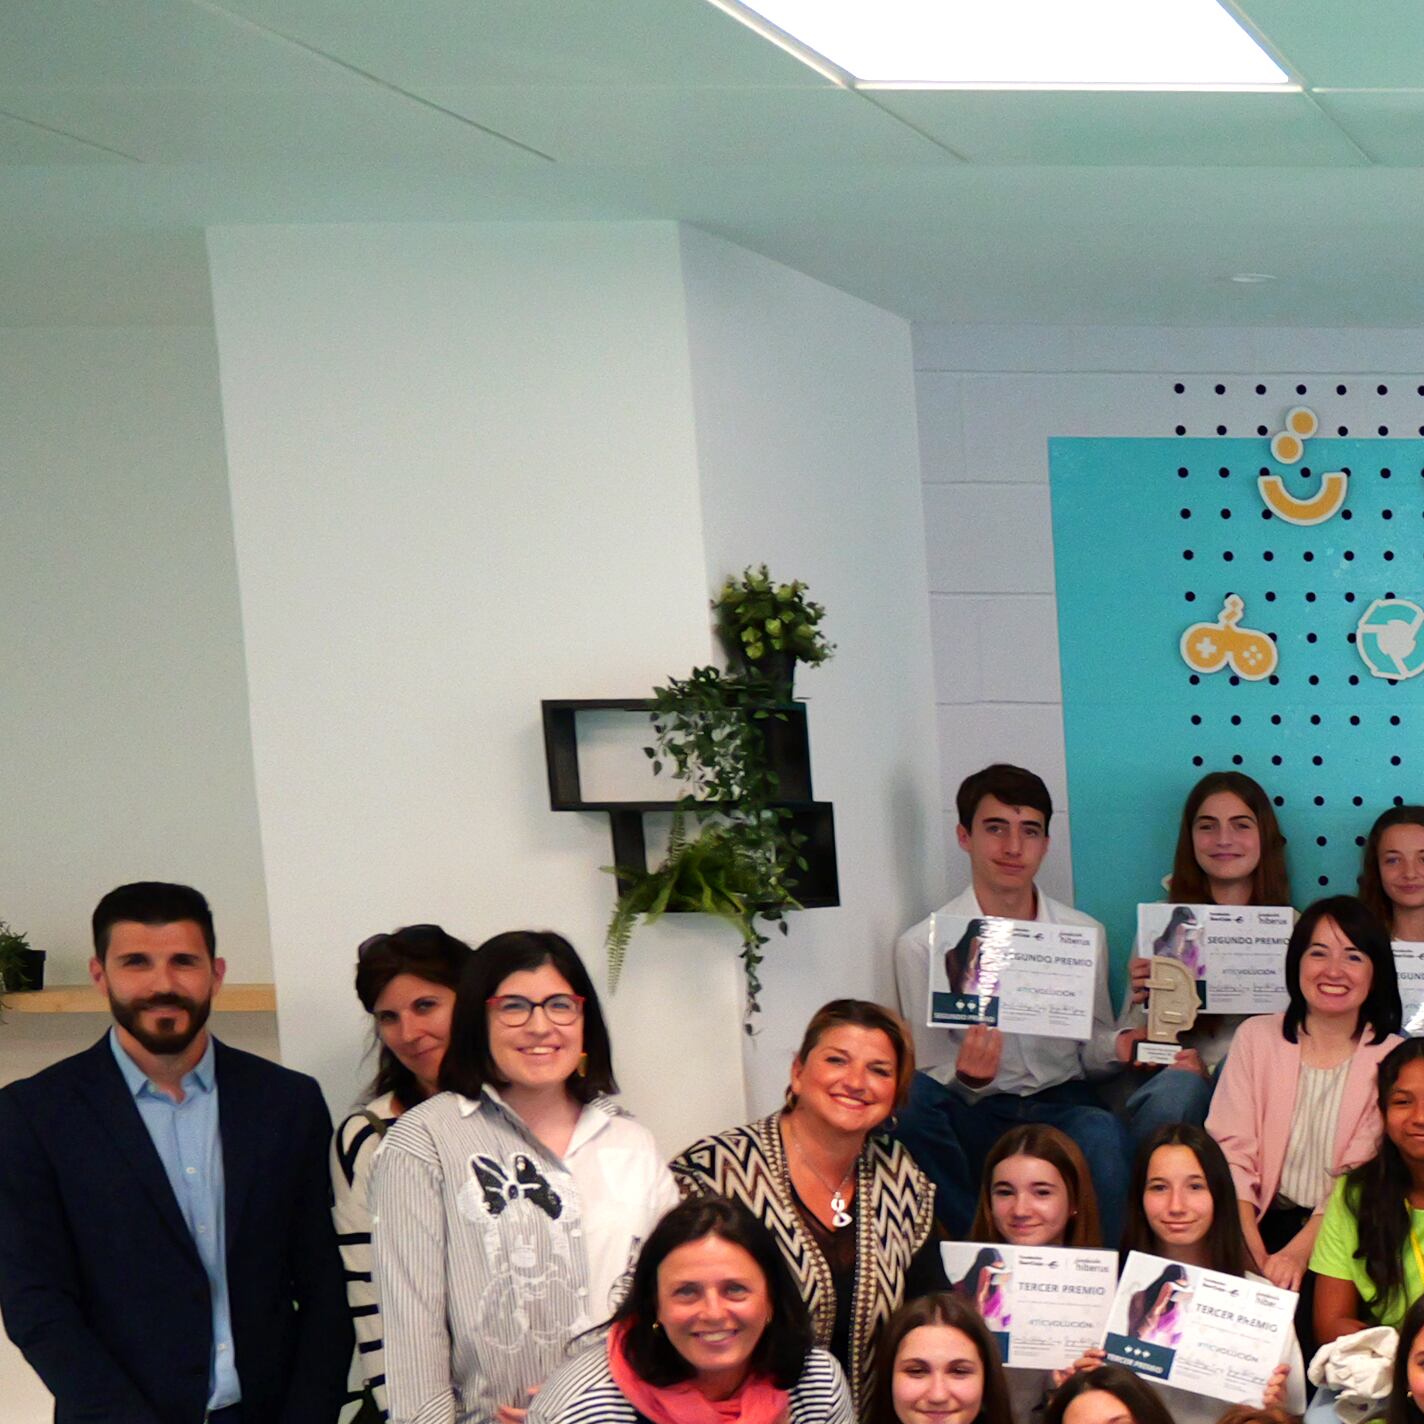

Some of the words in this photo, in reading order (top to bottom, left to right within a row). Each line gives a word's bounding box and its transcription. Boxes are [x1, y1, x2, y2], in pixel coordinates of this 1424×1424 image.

[1207, 936, 1253, 946] SEGUNDO
[1254, 936, 1290, 946] PREMIO
[1002, 952, 1053, 964] SGUNDO
[1054, 956, 1094, 968] PREMIO
[1018, 1282, 1059, 1293] TERCER
[1062, 1284, 1105, 1296] PREMIO
[1195, 1303, 1235, 1321] TERCER
[1236, 1314, 1278, 1333] PREMIO
